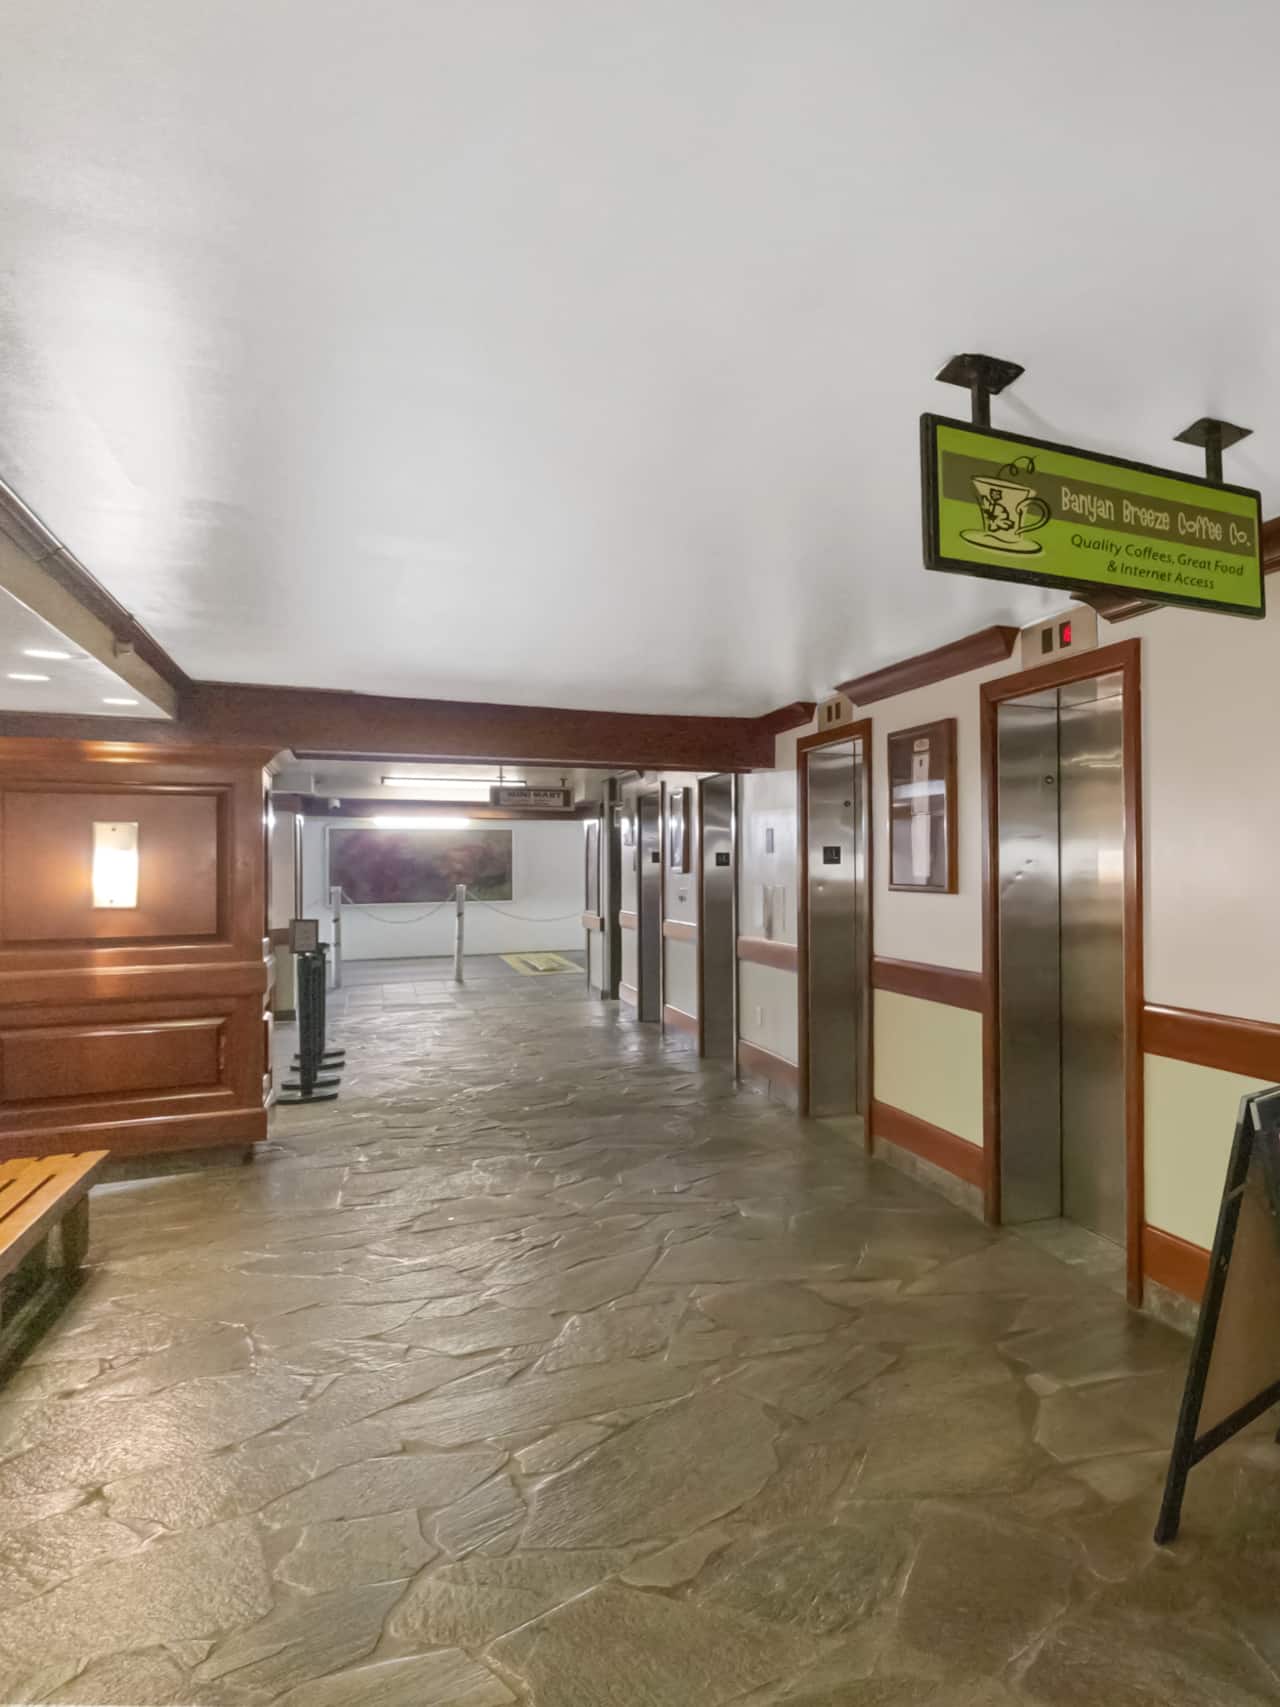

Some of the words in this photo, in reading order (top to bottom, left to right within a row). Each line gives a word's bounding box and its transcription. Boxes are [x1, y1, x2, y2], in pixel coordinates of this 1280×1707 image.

[1061, 486, 1115, 523] Banyan
[1122, 498, 1170, 531] Breeze
[1177, 511, 1223, 541] Coffee
[1229, 521, 1252, 547] Co.
[1071, 533, 1122, 556] Quality
[1124, 543, 1175, 566] Coffees,
[1177, 552, 1212, 571] Great
[1214, 559, 1244, 577] Food
[1106, 559, 1117, 574] &
[1120, 562, 1173, 583] Internet
[1174, 571, 1215, 590] Access
